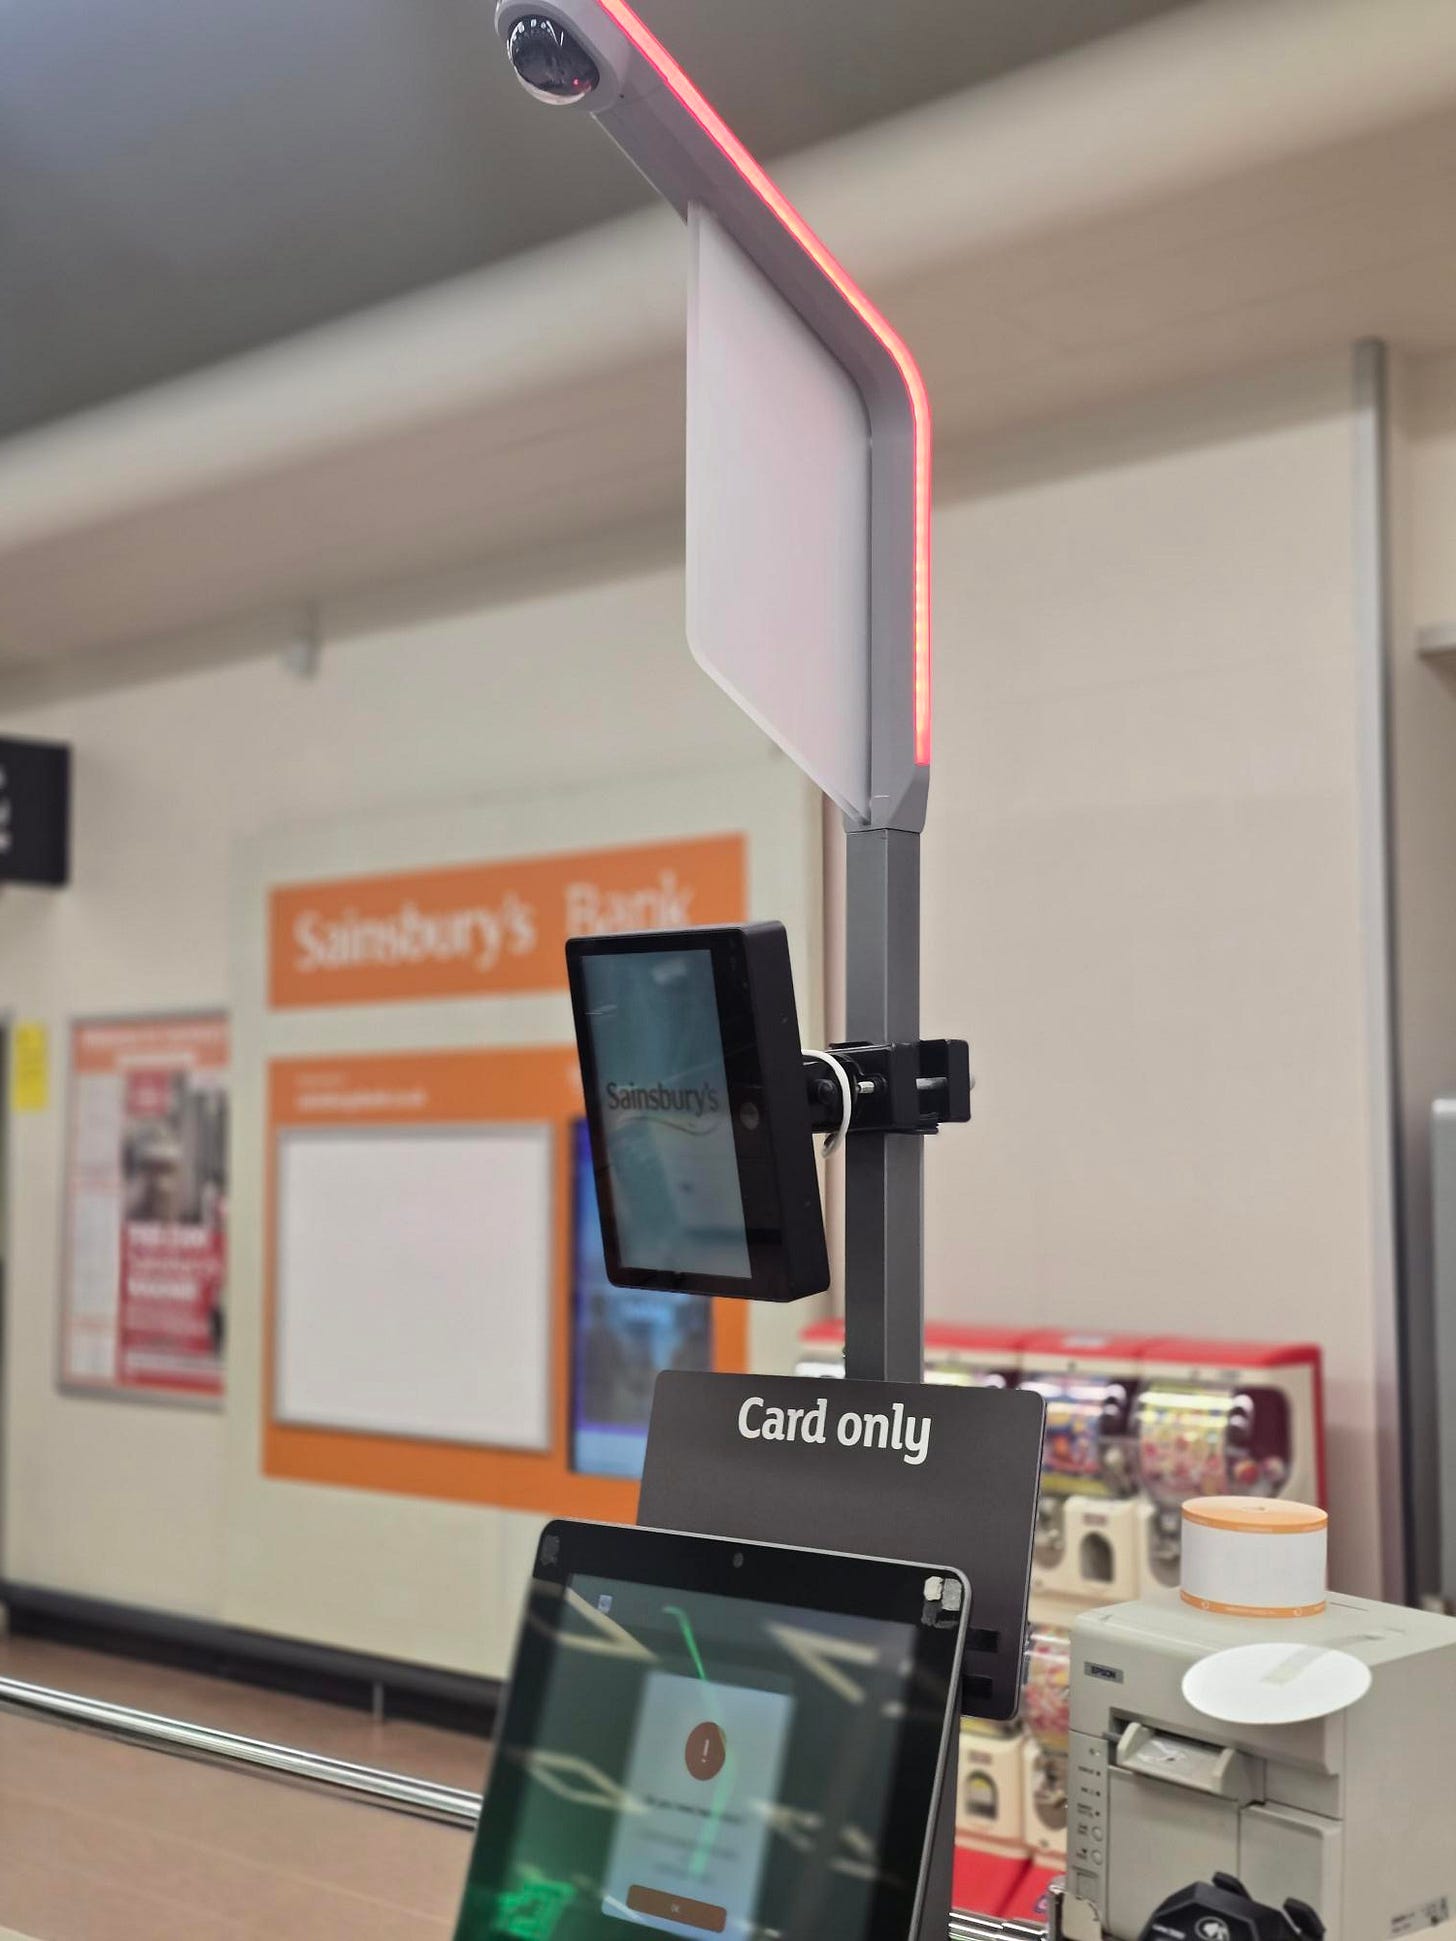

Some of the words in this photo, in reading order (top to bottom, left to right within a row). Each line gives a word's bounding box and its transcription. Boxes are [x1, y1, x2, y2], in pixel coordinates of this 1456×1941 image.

[294, 893, 536, 973] Sainsbury's
[566, 868, 692, 936] Bank
[606, 1081, 720, 1118] Sainsbury's
[738, 1396, 828, 1444] Card
[837, 1402, 931, 1465] only
